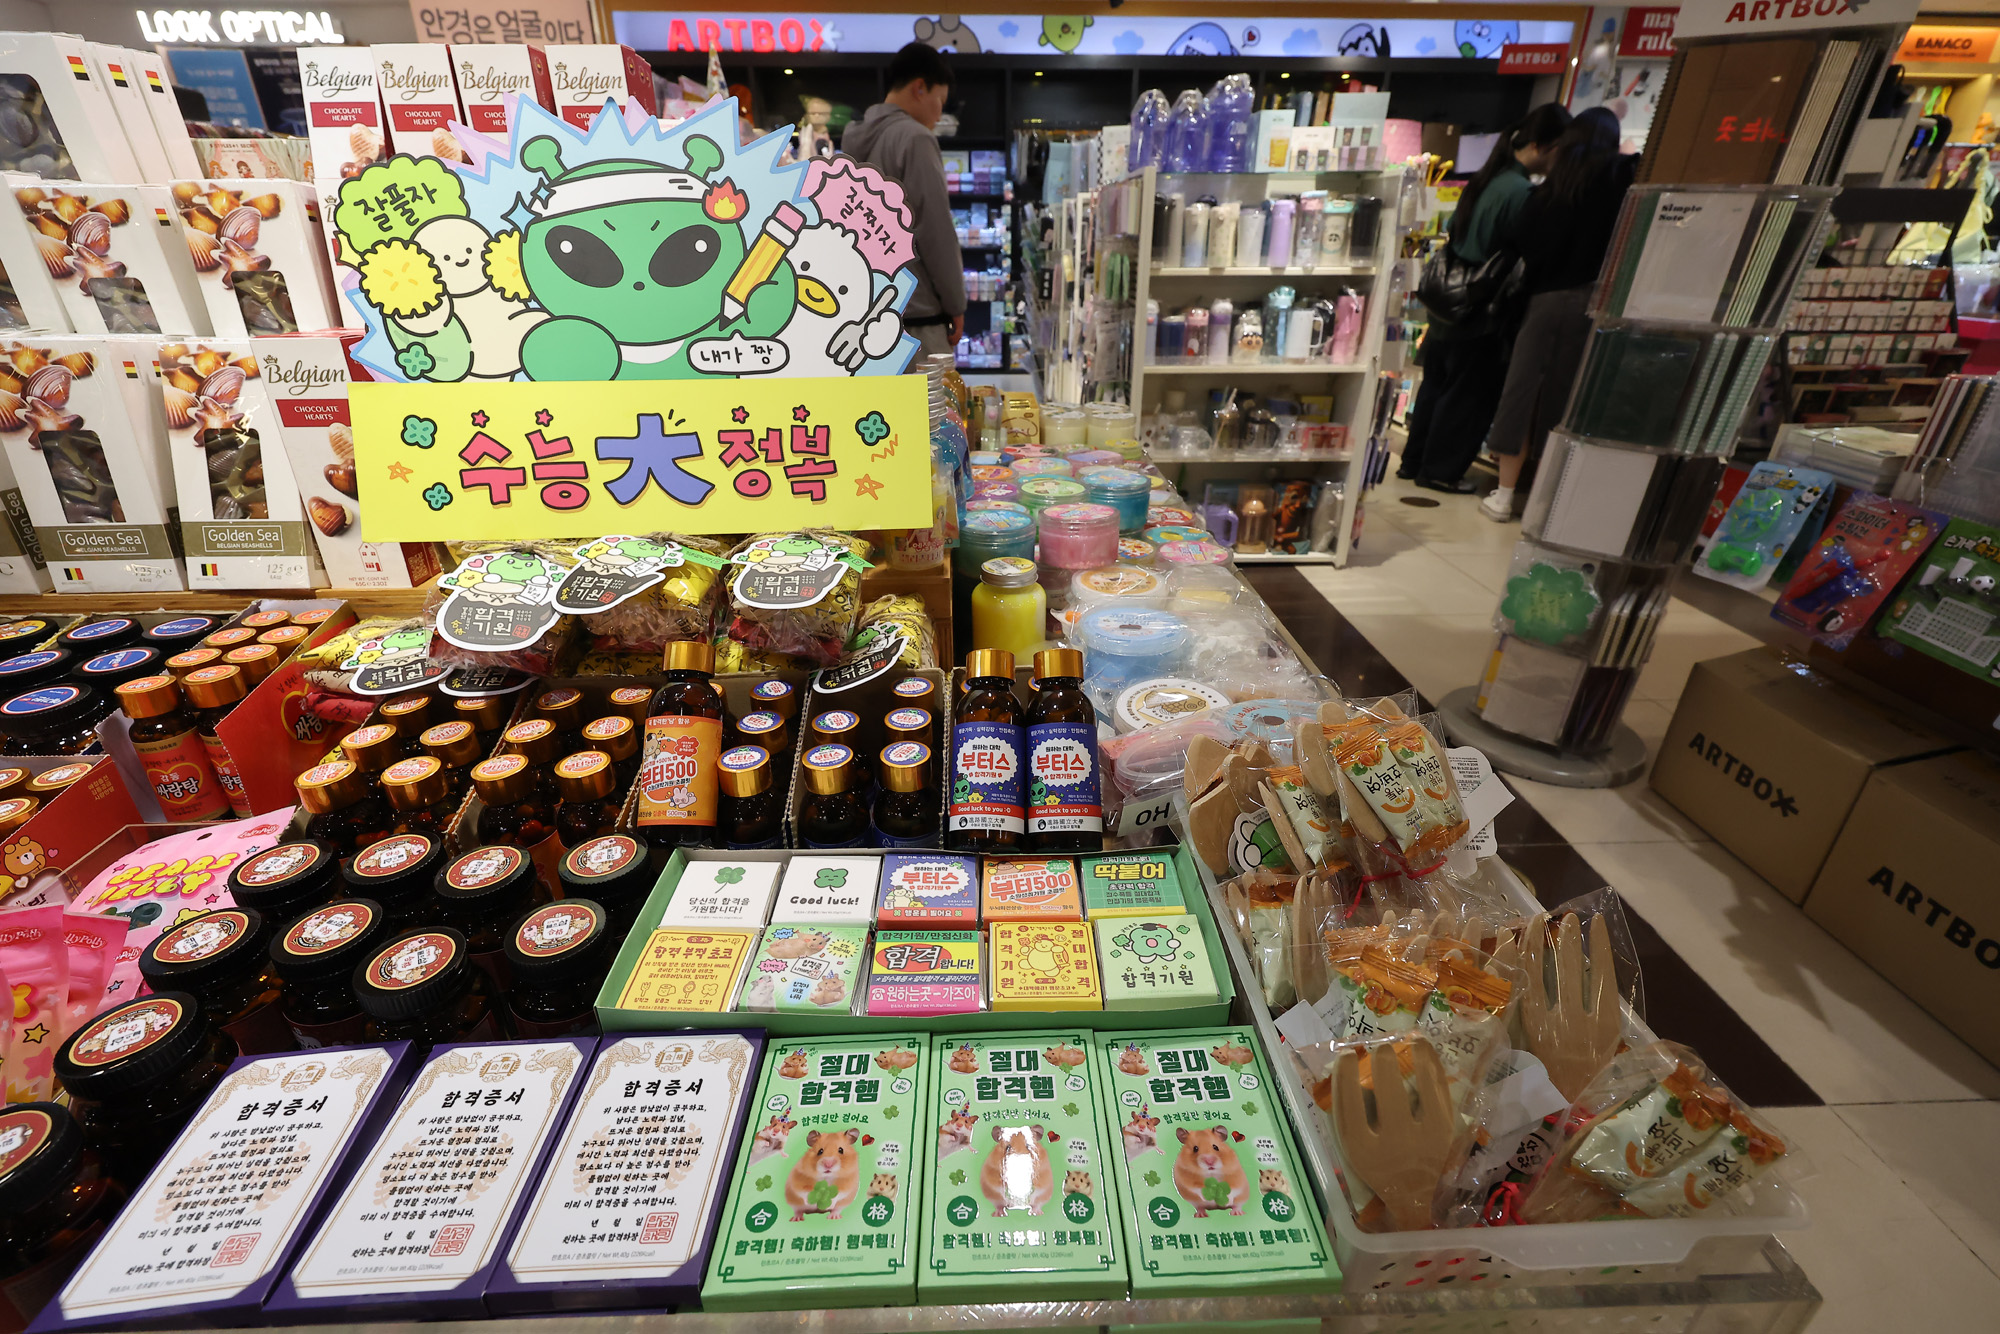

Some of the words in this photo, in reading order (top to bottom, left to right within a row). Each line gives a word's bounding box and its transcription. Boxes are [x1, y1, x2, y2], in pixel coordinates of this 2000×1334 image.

[1725, 0, 1870, 23] ARTBOX
[136, 10, 221, 43] LOOK
[220, 10, 345, 43] OPTICAL
[420, 8, 496, 44] 안경은
[495, 9, 585, 44] 얼굴이다
[667, 18, 843, 53] ARTBOX
[1915, 38, 1972, 50] BANACO
[305, 66, 374, 98] Belgian
[384, 66, 449, 101] Belgian
[463, 67, 531, 103] Belgian
[557, 67, 623, 103] Belgian
[324, 107, 363, 115] CHOCOLATE
[404, 111, 442, 119] CHOCOLATE
[413, 118, 437, 126] HEARTS
[353, 182, 437, 232] 잘풀자
[1661, 204, 1703, 214] Simple
[700, 346, 743, 365] 내가
[750, 344, 773, 365] 짱
[267, 360, 347, 396] Belgian
[294, 406, 339, 414] CHOCOLATE
[305, 413, 334, 421] HEARTS
[7, 492, 25, 517] Sea
[19, 517, 45, 564] Golden
[65, 532, 115, 547] Golden
[116, 533, 142, 545] Sea
[208, 529, 254, 542] Golden
[257, 529, 280, 541] Sea
[267, 564, 284, 574] 125
[580, 576, 613, 589] 합격
[765, 575, 800, 586] 합격
[576, 588, 605, 601] 기원
[765, 585, 799, 597] 기원
[474, 607, 515, 622] 합격
[473, 621, 512, 636] 기원
[961, 751, 1011, 770] 부터스
[1036, 753, 1085, 773] 부터스
[160, 772, 180, 782] 감동
[642, 760, 697, 793] 부터500
[1688, 732, 1799, 817] ARTBOX
[156, 777, 199, 800] 싸랑탕
[107, 851, 240, 887] BEARS
[1095, 863, 1166, 880] 딱붙어
[902, 872, 959, 884] 부터스
[88, 872, 215, 910] JELLY
[990, 873, 1071, 901] 부터500
[689, 897, 718, 906] 당신의
[722, 897, 750, 906] 합격을
[690, 905, 743, 914] 기원합니다!
[790, 896, 823, 905] Good
[827, 896, 860, 906] luck!
[904, 909, 927, 917] 행운을
[930, 909, 952, 917] 빌어요
[654, 945, 681, 959] 합격
[683, 947, 707, 959] 부적
[707, 948, 733, 959] 초코
[884, 945, 942, 970] 합격
[940, 959, 974, 969] 합니다!
[1121, 970, 1194, 988] 합격기원
[820, 1053, 871, 1077] 절대
[989, 1050, 1039, 1073] 절대
[1156, 1050, 1209, 1074] 절대
[624, 1079, 703, 1098] 합격증서
[800, 1080, 879, 1106] 합격햄
[975, 1076, 1055, 1101] 합격햄
[1148, 1076, 1232, 1103] 합격햄
[441, 1088, 525, 1108] 합격증서
[236, 1096, 329, 1121] 합격증서
[640, 1105, 670, 1113] 밤낮없이
[673, 1104, 707, 1112] 공부하고,
[1163, 1111, 1200, 1124] 합격길만
[1203, 1110, 1232, 1121] 걸어요
[642, 1115, 666, 1123] 노력과
[669, 1115, 686, 1124] 집념,
[802, 1114, 839, 1126] 합격길만
[842, 1113, 869, 1124] 걸어요
[608, 1127, 633, 1135] 뜨거운
[636, 1126, 659, 1134] 열정과
[581, 1139, 614, 1148] 누구보다
[617, 1138, 641, 1146] 뛰어난
[645, 1137, 666, 1145] 실력을
[576, 1151, 601, 1159] 매시간
[604, 1150, 628, 1158] 노력과
[632, 1149, 655, 1157] 최선을
[579, 1162, 612, 1171] 평소보다
[646, 1160, 670, 1168] 점수를
[674, 1160, 691, 1168] 받아
[588, 1173, 620, 1183] 틀림없이
[623, 1173, 648, 1182] 원하는
[651, 1172, 669, 1181] 곳에
[595, 1186, 619, 1195] 합격할
[623, 1185, 657, 1194] 것이기에
[564, 1200, 581, 1209] 미리
[584, 1200, 592, 1208] 이
[596, 1198, 629, 1208] 합격증을
[632, 1197, 677, 1206] 수여합니다.
[868, 1203, 888, 1220] 格
[953, 1203, 973, 1220] 合
[1069, 1201, 1088, 1218] 格
[1269, 1198, 1289, 1216] 格
[752, 1209, 772, 1226] 合
[1153, 1204, 1174, 1220] 合
[591, 1219, 599, 1228] 년
[635, 1217, 644, 1226] 일
[562, 1235, 586, 1244] 원하는
[588, 1233, 606, 1243] 곳에
[735, 1239, 784, 1255] 합격햄!
[791, 1236, 840, 1251] 축하햄!
[1151, 1234, 1200, 1250] 합격햄!
[1206, 1232, 1255, 1249] 축하햄!
